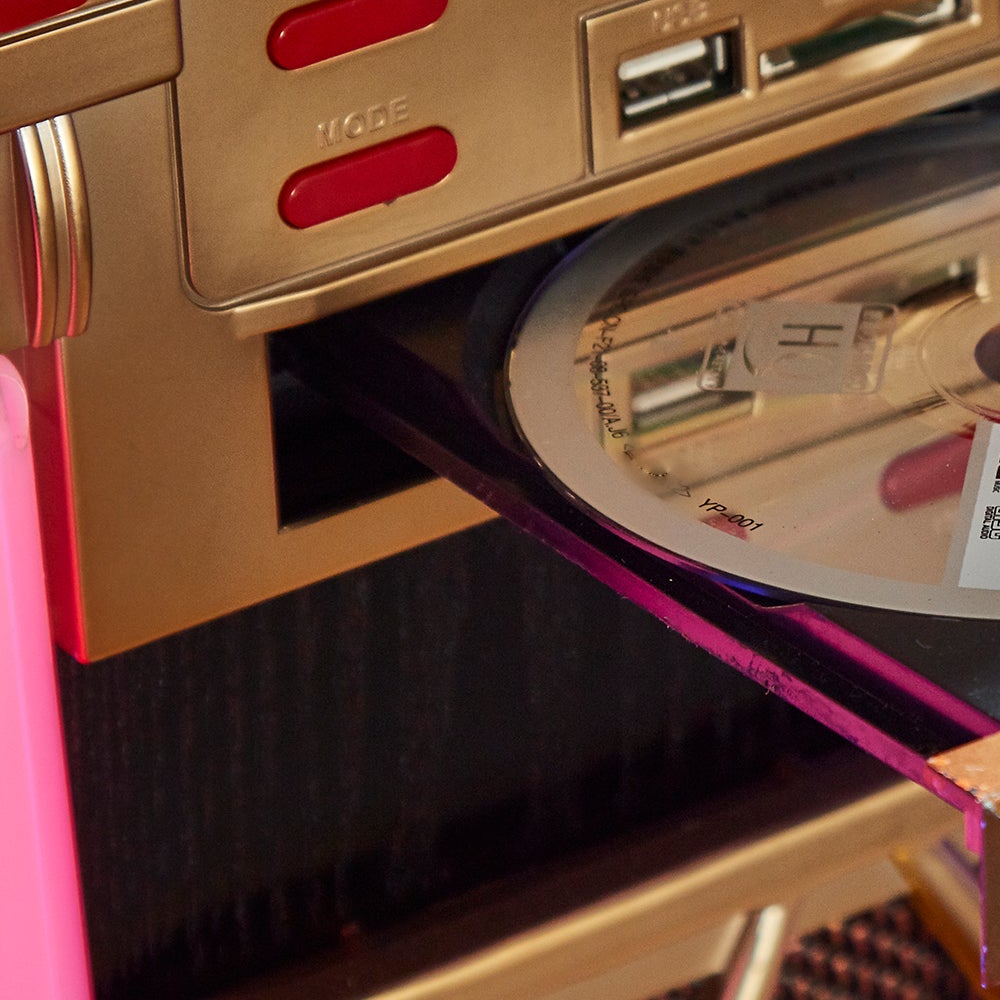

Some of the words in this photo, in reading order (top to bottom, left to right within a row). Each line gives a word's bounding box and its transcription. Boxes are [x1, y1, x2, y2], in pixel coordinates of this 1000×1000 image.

[316, 96, 410, 149] MODE
[699, 498, 764, 531] YP-001
[983, 506, 995, 523] DIGITAL
[980, 525, 990, 540] AUDIO
